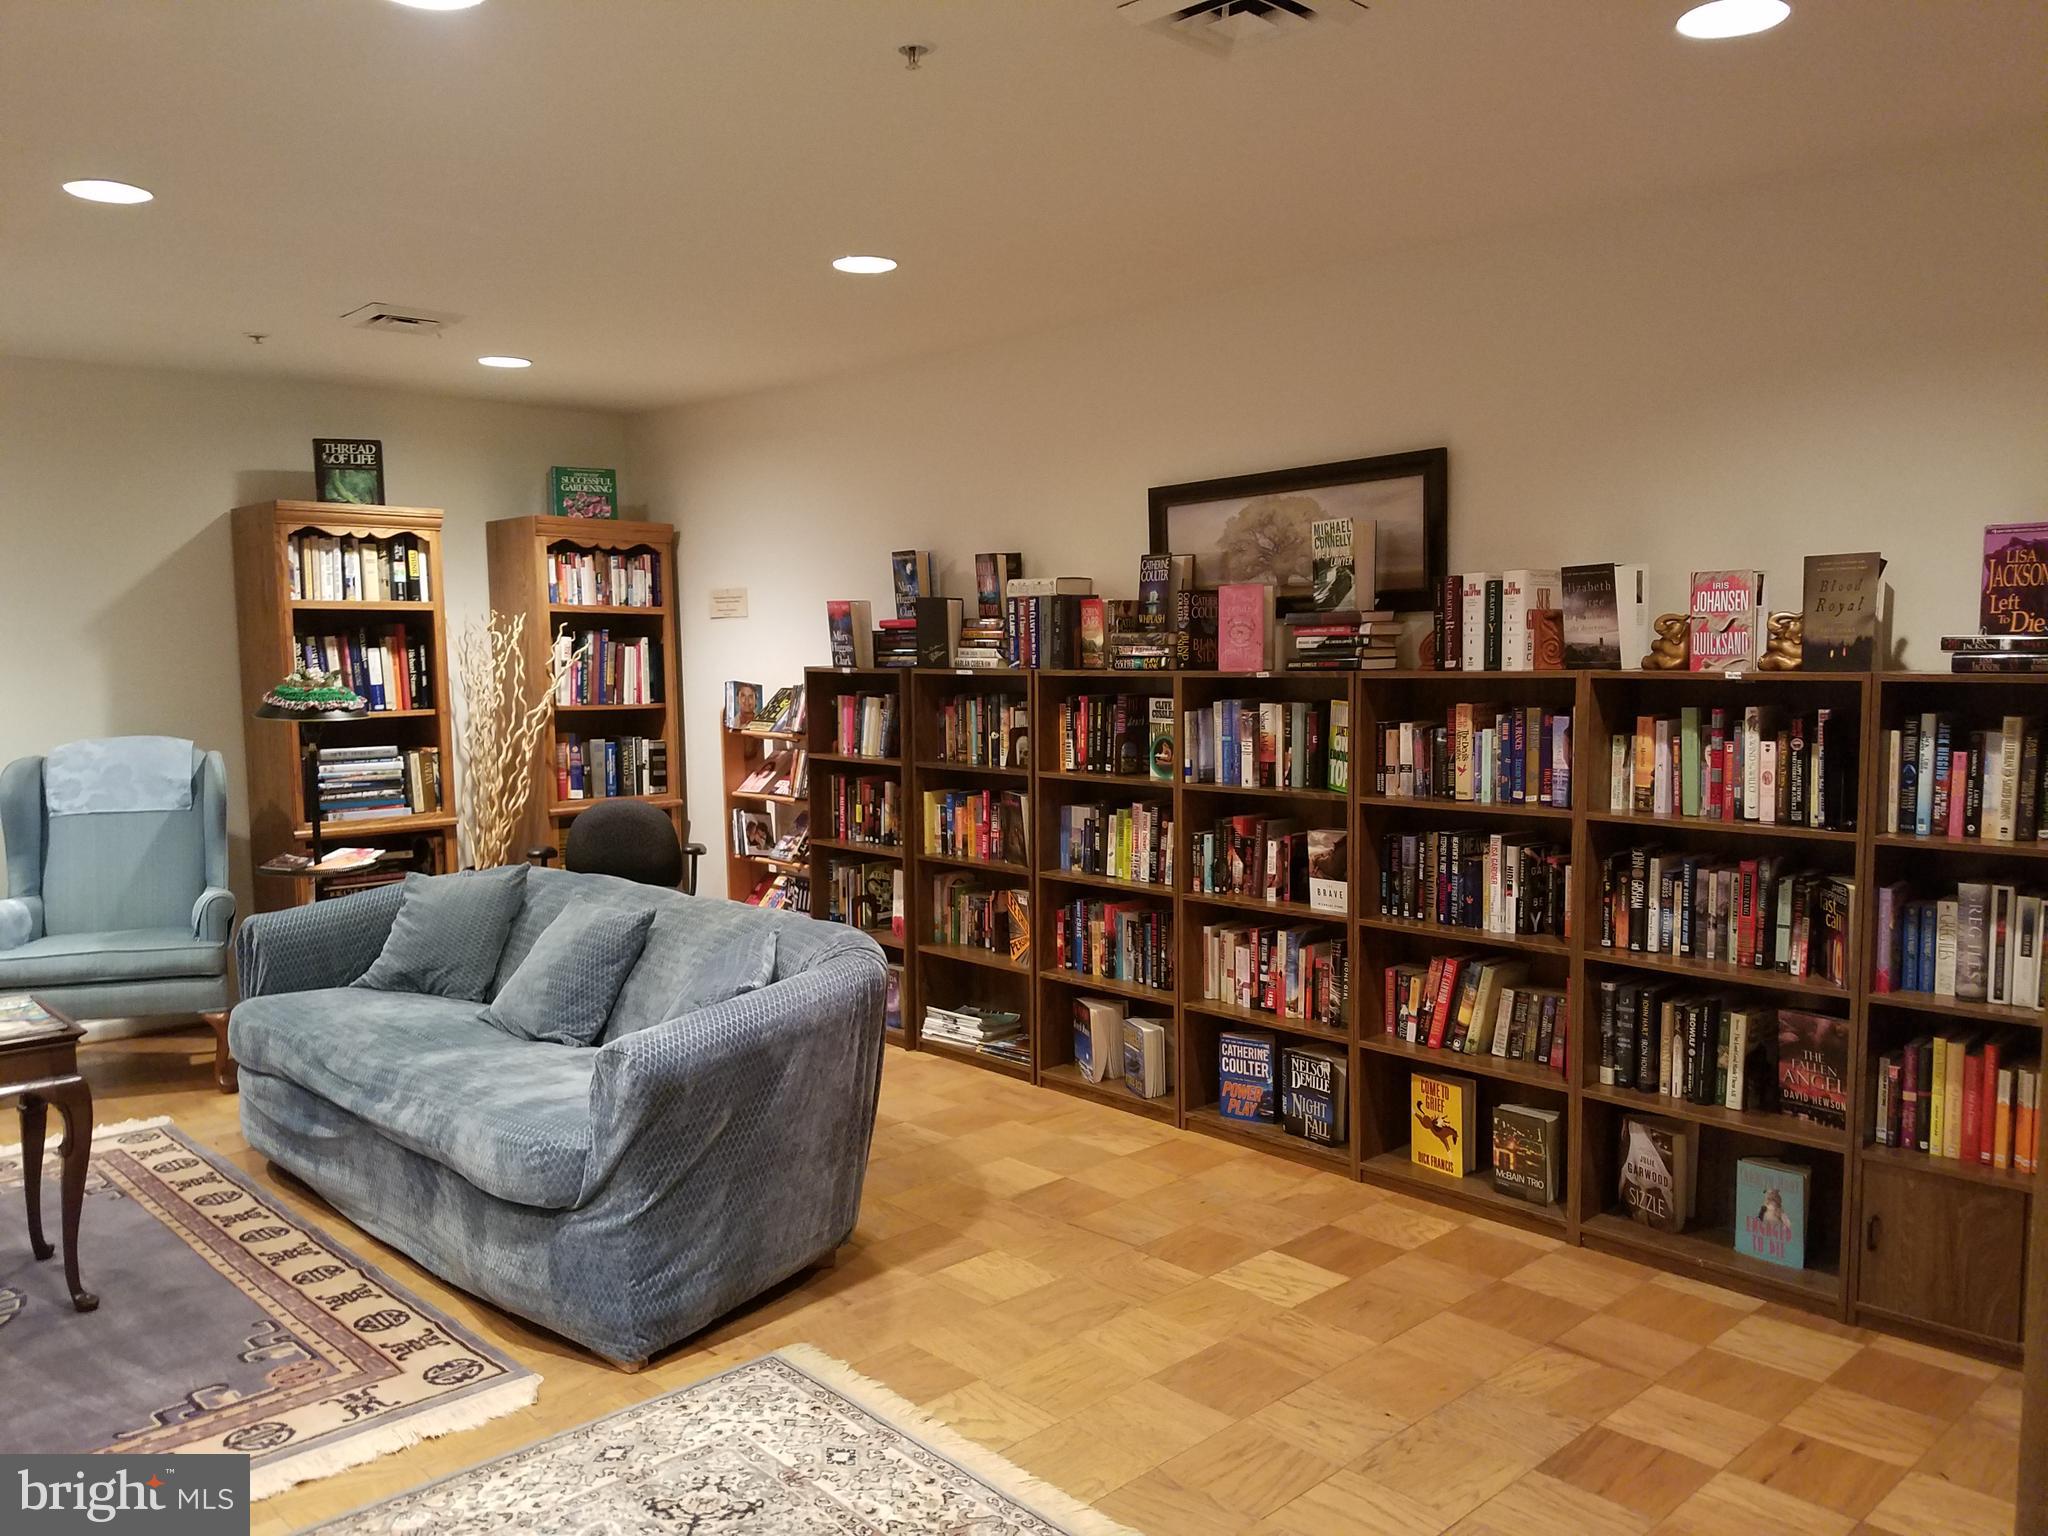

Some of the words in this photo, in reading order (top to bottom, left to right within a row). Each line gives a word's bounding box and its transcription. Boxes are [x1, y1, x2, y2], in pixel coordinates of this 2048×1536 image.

[323, 444, 375, 454] THREAD
[331, 455, 348, 464] OF
[350, 455, 376, 464] LIFE
[561, 476, 612, 486] SUCCESSFUL
[561, 484, 612, 493] GARDENING
[1313, 520, 1351, 536] MICHAEL
[1314, 533, 1351, 549] CONNELLY
[410, 552, 418, 575] THINK
[1142, 559, 1169, 571] CATHERINE
[1330, 556, 1353, 567] LAWYER
[2006, 548, 2037, 563] LISA
[1141, 569, 1169, 582] COULTER
[1464, 589, 1481, 597] GRAFTON
[1819, 579, 1863, 593] Blood
[1536, 588, 1550, 608] SUE
[1693, 590, 1749, 612] JOHANSEN
[1816, 597, 1864, 617] Royal
[1990, 594, 2020, 613] Left
[1008, 614, 1016, 637] CLANCY
[1029, 612, 1037, 632] CLANCY
[1139, 614, 1166, 624] WHIPLASH
[1445, 621, 1455, 630] R
[1488, 623, 1496, 633] Y
[1998, 614, 2010, 624] To
[2009, 610, 2045, 633] Die
[833, 630, 848, 645] Mary
[1693, 632, 1748, 656] QUICKSAND
[1963, 642, 1996, 650] JACKSON
[835, 655, 852, 666] Clark
[1260, 711, 1269, 730] Nelson
[1461, 729, 1469, 741] The
[1514, 727, 1523, 750] FRANCIS
[1937, 722, 1951, 743] JACK
[1461, 741, 1469, 762] Devil's
[1904, 736, 1918, 761] HIGGINS
[1936, 747, 1950, 780] HIGGINS
[1631, 850, 1645, 868] JOHN
[1490, 859, 1498, 885] GARDNER
[1317, 887, 1343, 899] BRAVE
[1426, 865, 1435, 908] TAKEOVER
[1451, 876, 1459, 901] STEPHEN
[1631, 879, 1645, 909] GRISHAM
[1743, 874, 1751, 895] BRIAN
[1451, 902, 1459, 917] FREY
[1743, 898, 1751, 916] HAIG
[1968, 892, 1984, 937] GREG
[1939, 914, 1956, 941] GREG
[1938, 943, 1955, 961] ILES
[1968, 943, 1984, 980] ILES
[1444, 963, 1455, 977] JULIE
[1438, 978, 1452, 1004] GARWOOD
[1641, 1018, 1649, 1036] HART
[1688, 1013, 1697, 1048] BEOWULF
[1222, 1043, 1269, 1061] CATHERINE
[1641, 1039, 1649, 1056] IRON
[1803, 1050, 1824, 1062] THE
[1221, 1057, 1269, 1078] COULTER
[1290, 1058, 1331, 1079] NELSON
[1640, 1057, 1648, 1079] HOUSE
[1792, 1058, 1840, 1077] FALLEN
[1221, 1080, 1263, 1102] POWER
[1291, 1070, 1331, 1093] DEMILLE
[1420, 1079, 1441, 1097] COME
[1441, 1084, 1450, 1100] TO
[1784, 1071, 1847, 1094] ANGEL
[1227, 1098, 1258, 1117] PLAY
[1291, 1092, 1328, 1119] NIGHT
[1425, 1094, 1445, 1113] GRIEF
[1783, 1090, 1809, 1103] DAVID
[1811, 1095, 1847, 1110] HEWSON
[1303, 1113, 1330, 1138] FALL
[1417, 1151, 1430, 1166] DICK
[1430, 1154, 1454, 1174] FRANCIS
[1639, 1155, 1655, 1167] JULIE
[1496, 1168, 1525, 1184] McBAIN
[1526, 1176, 1545, 1189] TRIO
[1627, 1162, 1669, 1188] GARWOOD
[1629, 1187, 1665, 1218] SIZZLE
